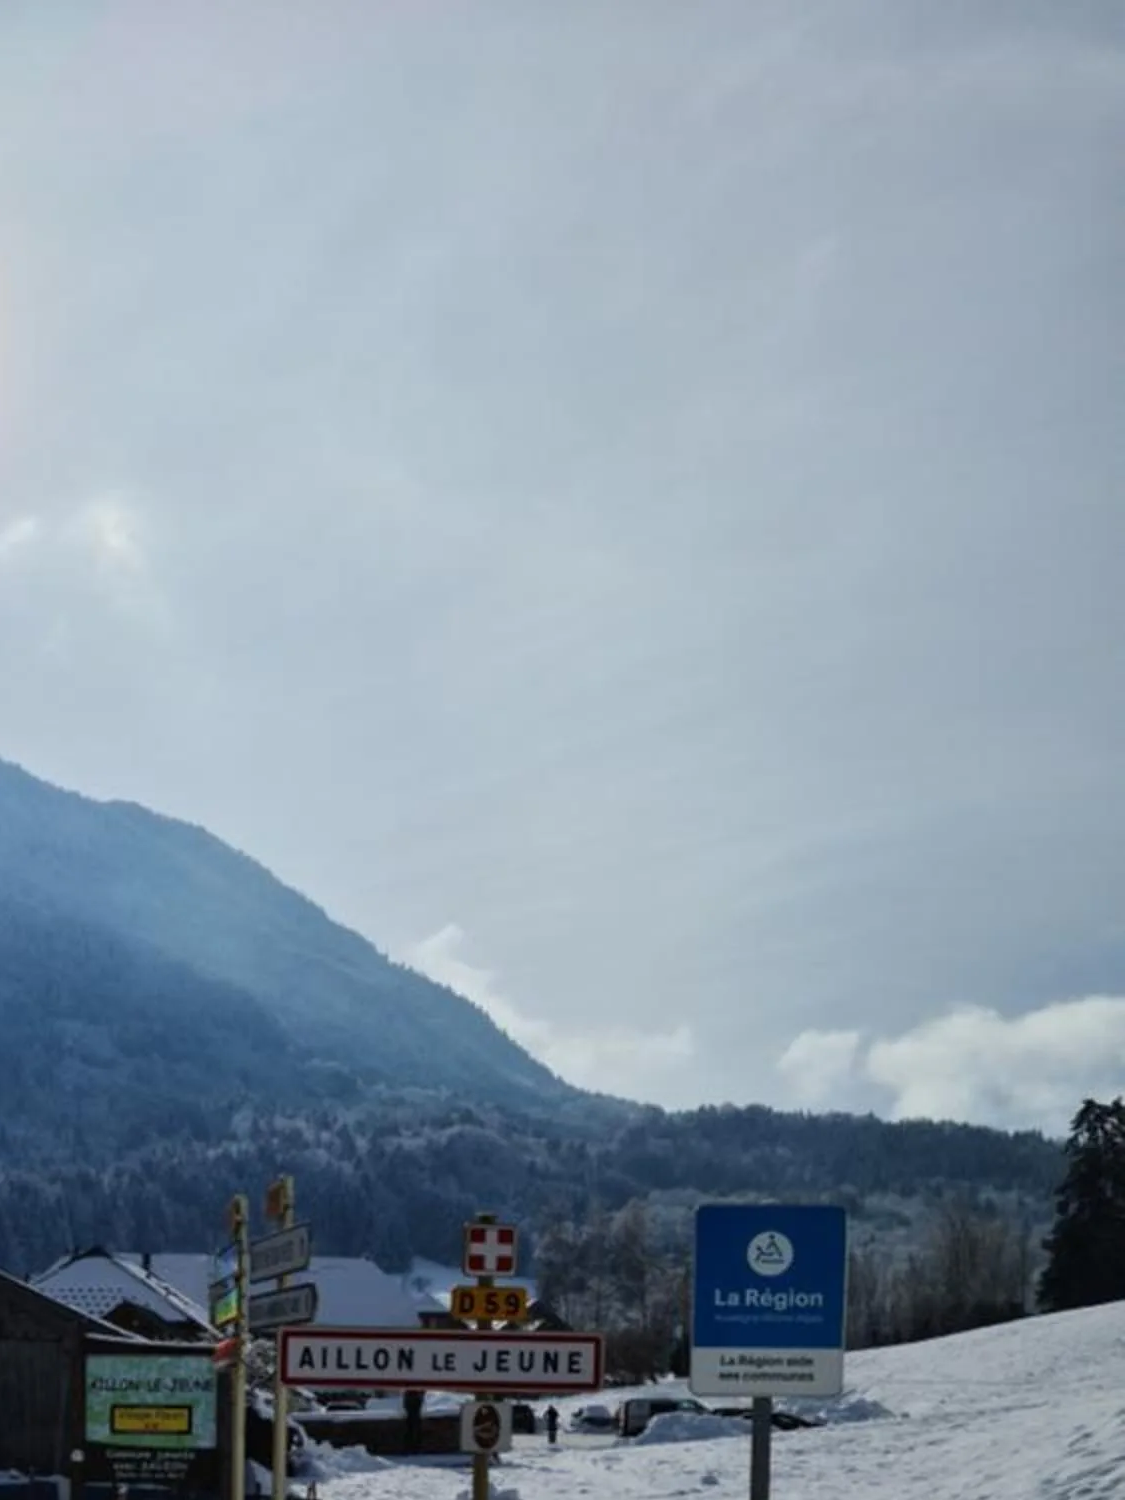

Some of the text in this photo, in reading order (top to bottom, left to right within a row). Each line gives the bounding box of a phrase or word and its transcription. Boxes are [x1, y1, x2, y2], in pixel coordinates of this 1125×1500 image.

[459, 1291, 521, 1315] D 59
[714, 1287, 824, 1311] La Région
[299, 1346, 583, 1374] AILLON LE JEUNE
[720, 1354, 736, 1366] La
[738, 1353, 784, 1368] Région
